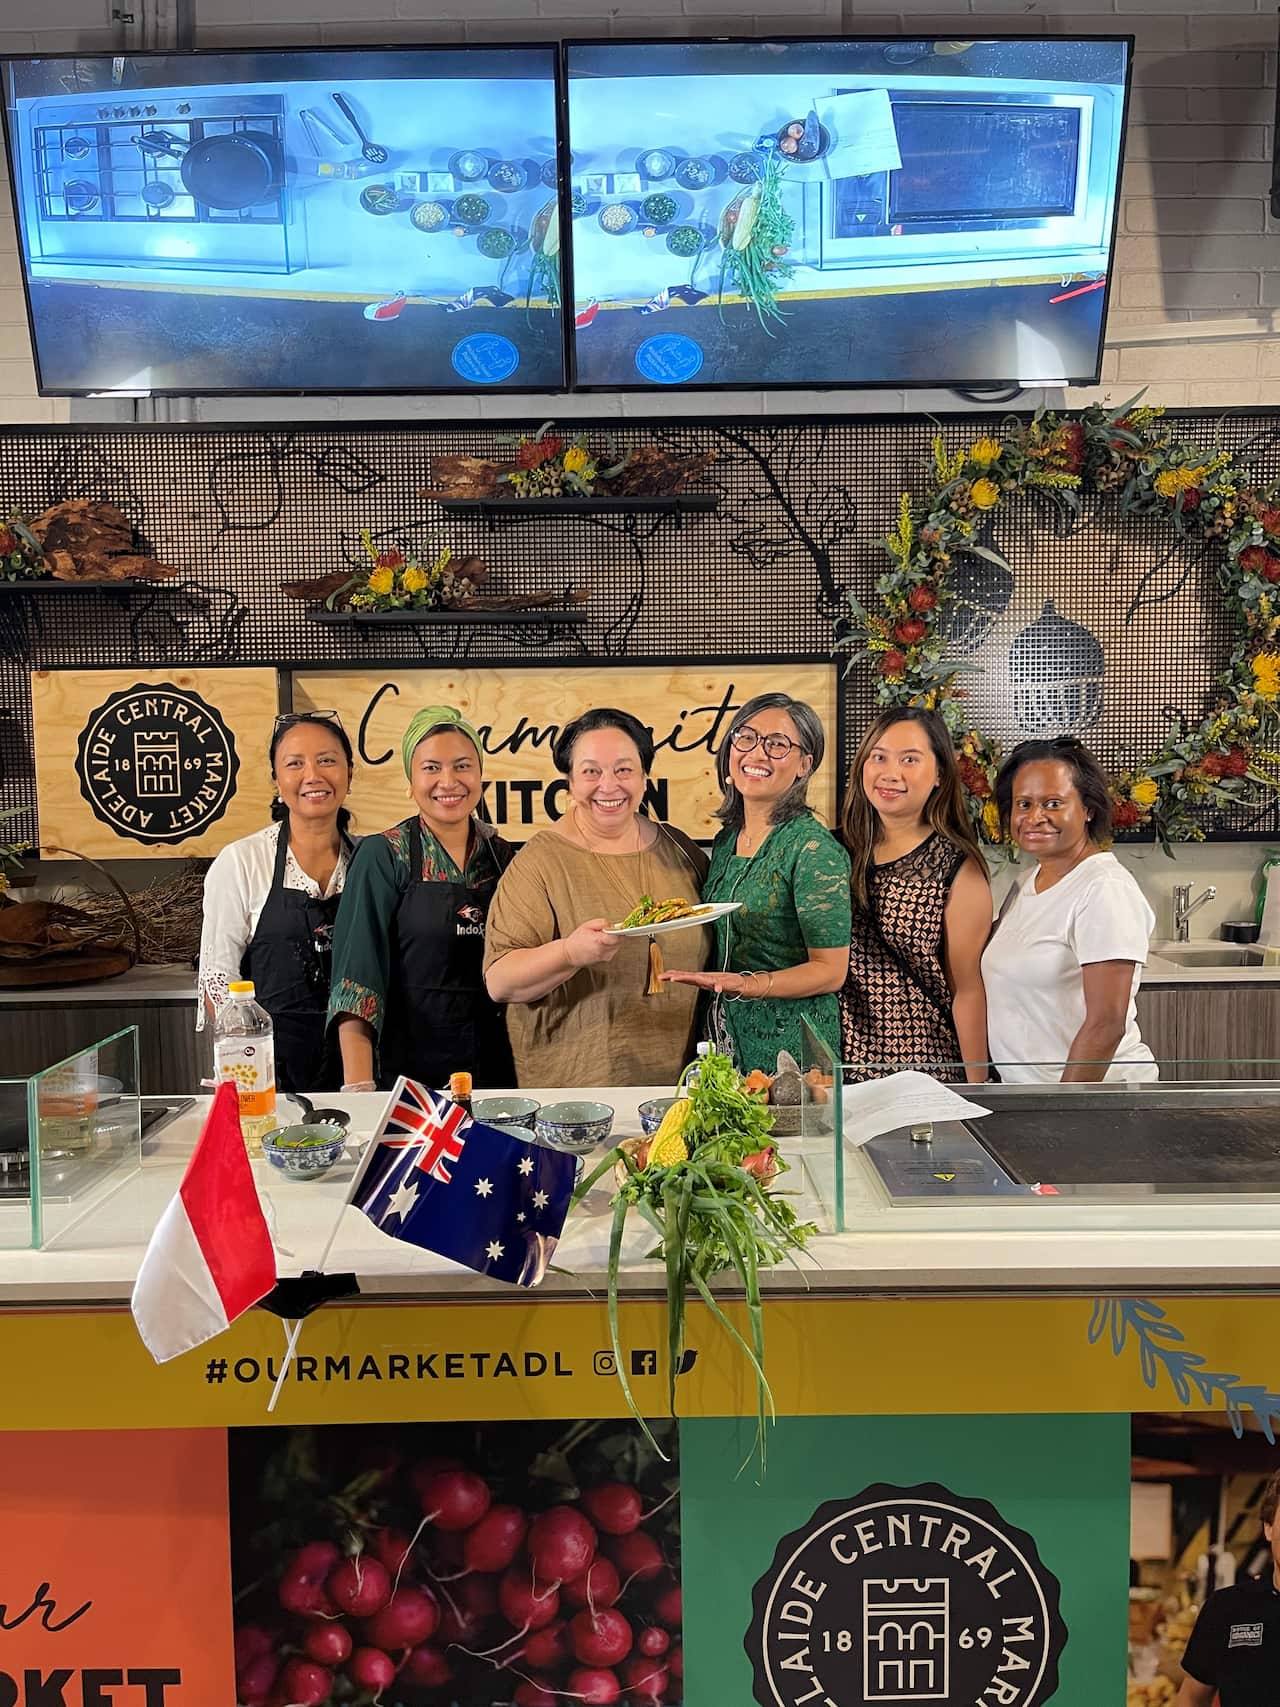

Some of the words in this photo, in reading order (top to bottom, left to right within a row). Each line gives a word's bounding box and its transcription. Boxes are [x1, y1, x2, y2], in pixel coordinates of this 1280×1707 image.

[116, 698, 213, 744] CENTRAL
[91, 727, 154, 829] ADELAIDE
[114, 758, 130, 771] 18
[183, 757, 202, 770] 69
[168, 751, 224, 829] MARKET
[205, 1351, 573, 1384] #OURMARKETADL
[830, 1514, 1017, 1600] CENTRAL
[821, 1630, 852, 1652] 18
[958, 1627, 993, 1649] 69
